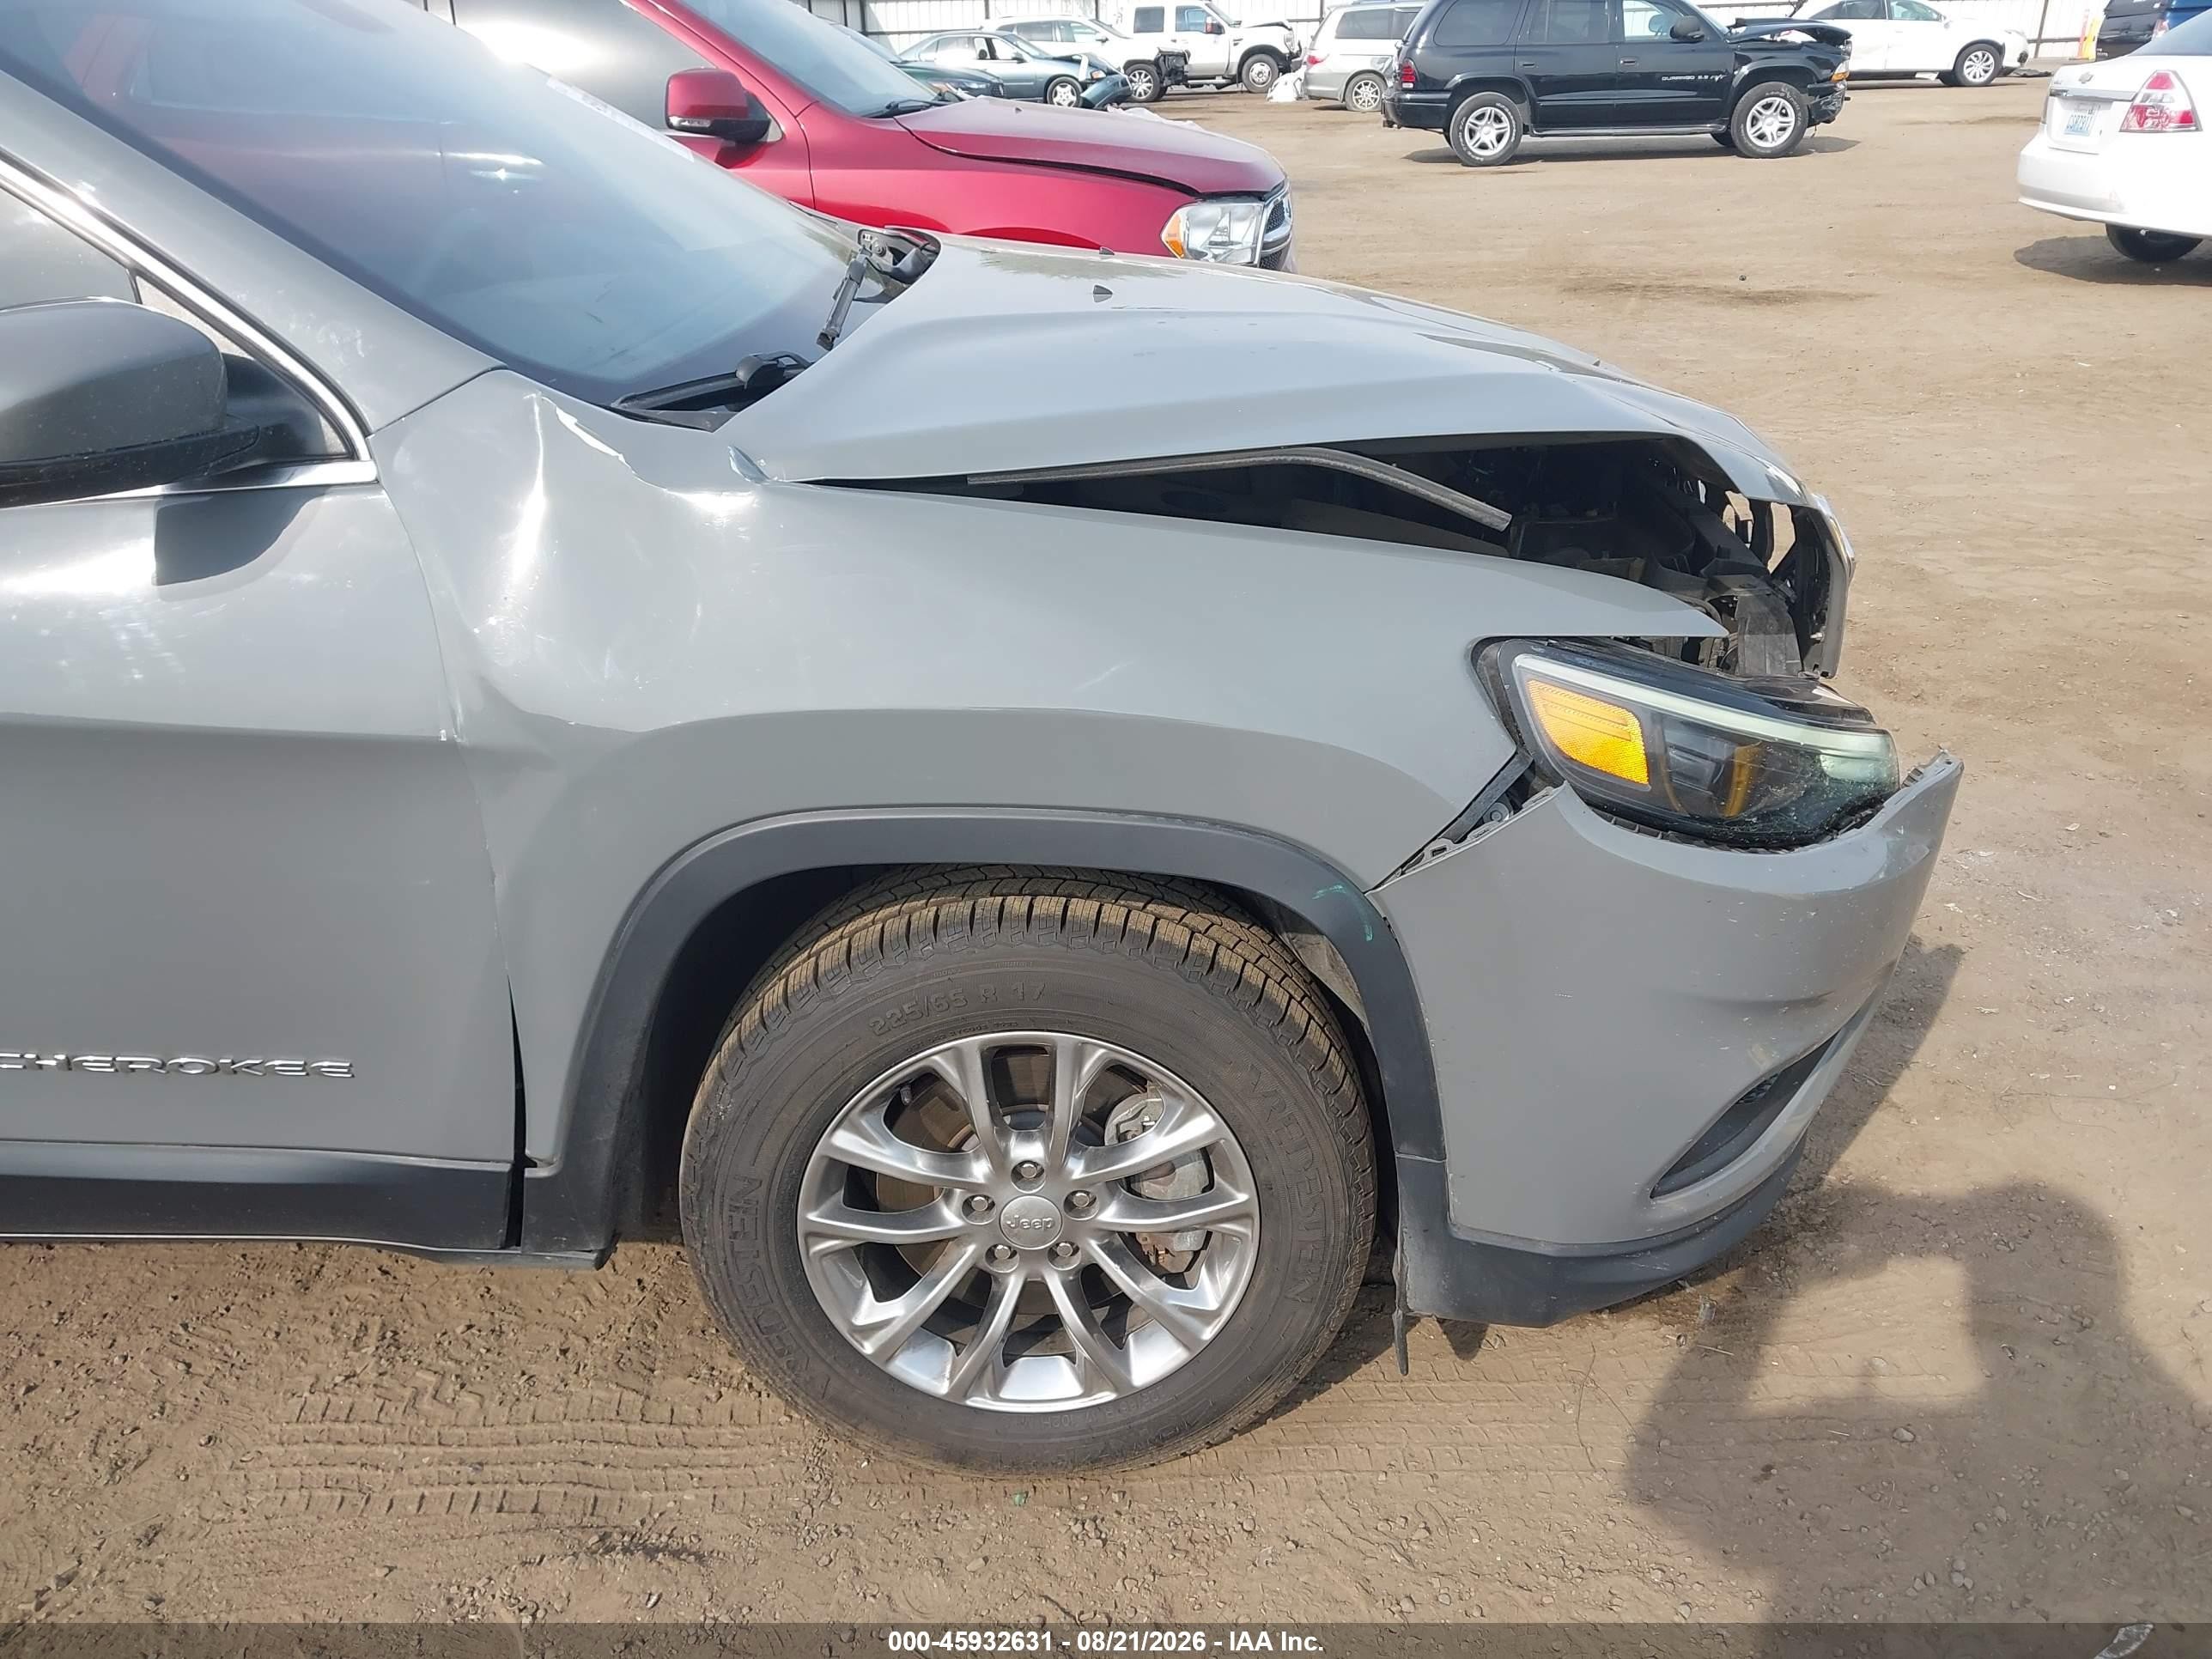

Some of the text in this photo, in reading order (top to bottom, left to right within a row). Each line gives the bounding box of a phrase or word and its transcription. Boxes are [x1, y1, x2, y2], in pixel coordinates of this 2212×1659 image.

[981, 987, 999, 1003] R
[1014, 983, 1047, 1002] 17
[1006, 1214, 1054, 1231] Jeep
